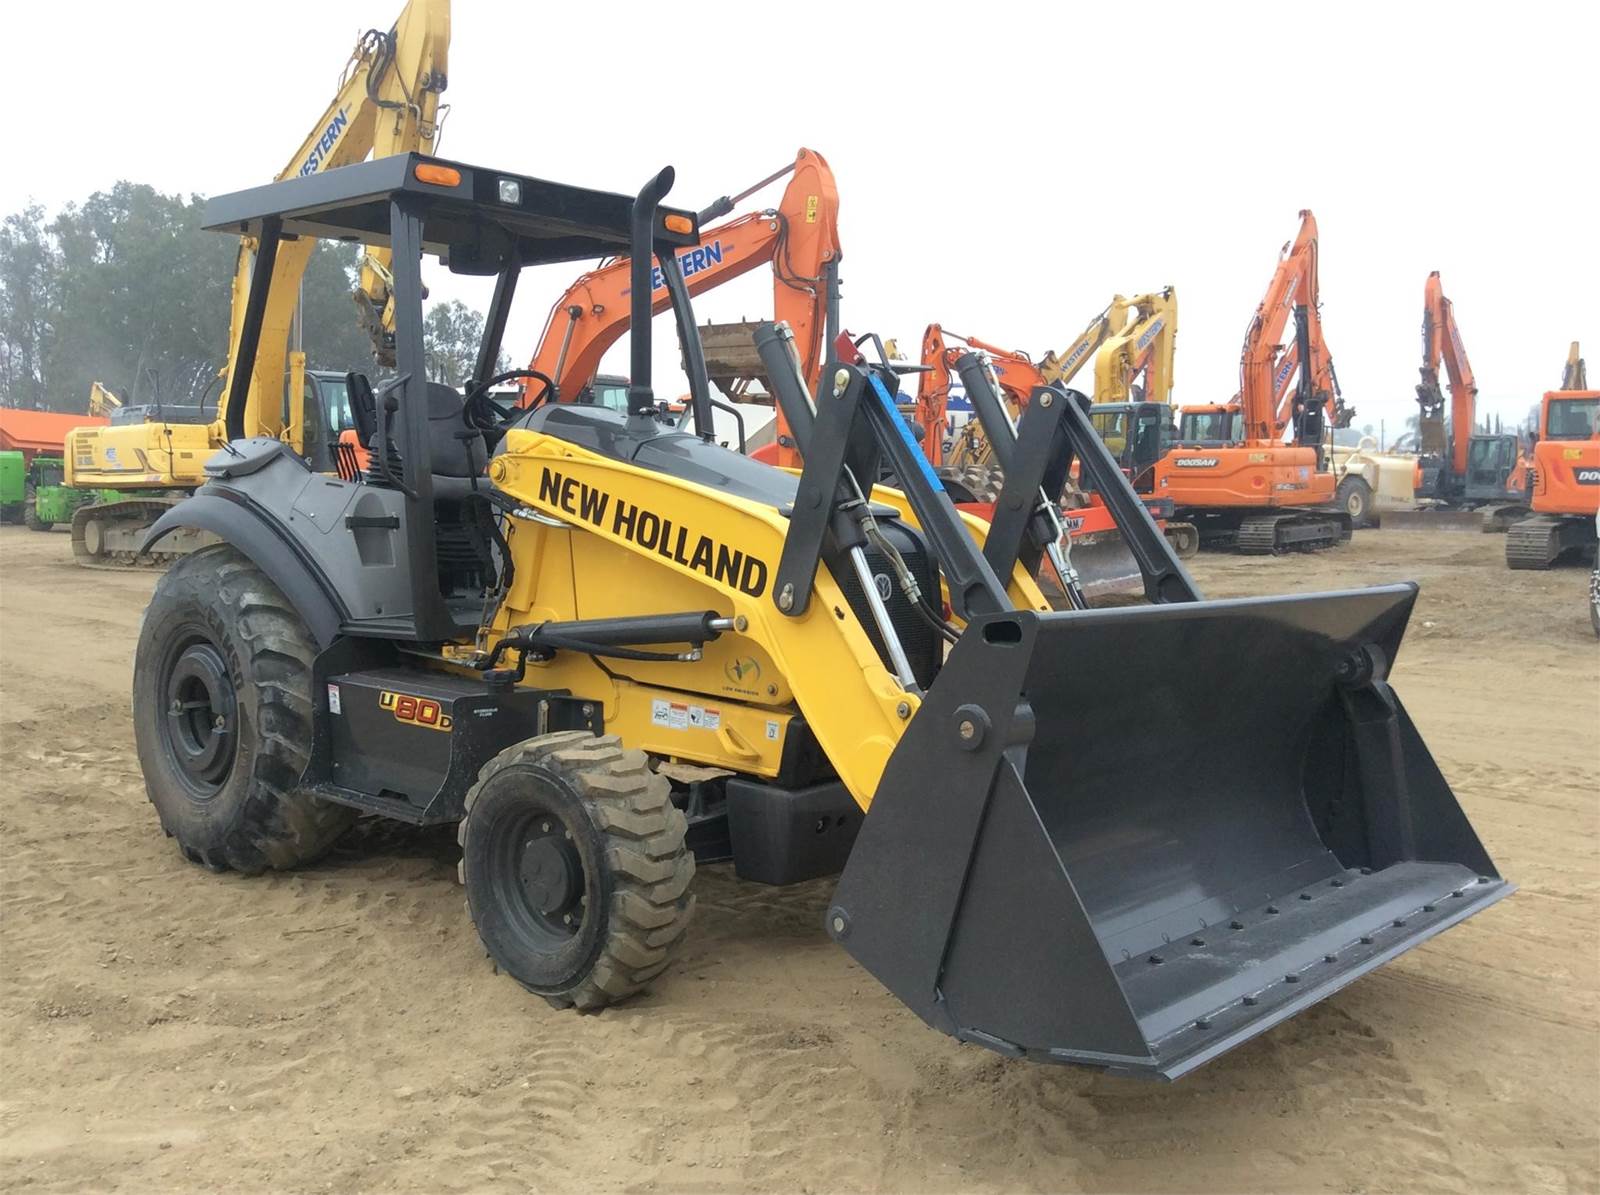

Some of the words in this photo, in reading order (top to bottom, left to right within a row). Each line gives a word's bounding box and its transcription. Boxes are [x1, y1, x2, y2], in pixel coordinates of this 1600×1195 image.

[300, 108, 347, 176] ESTERN
[1061, 340, 1089, 372] WESTERN
[539, 467, 609, 527] NEW
[612, 498, 768, 598] HOLLAND
